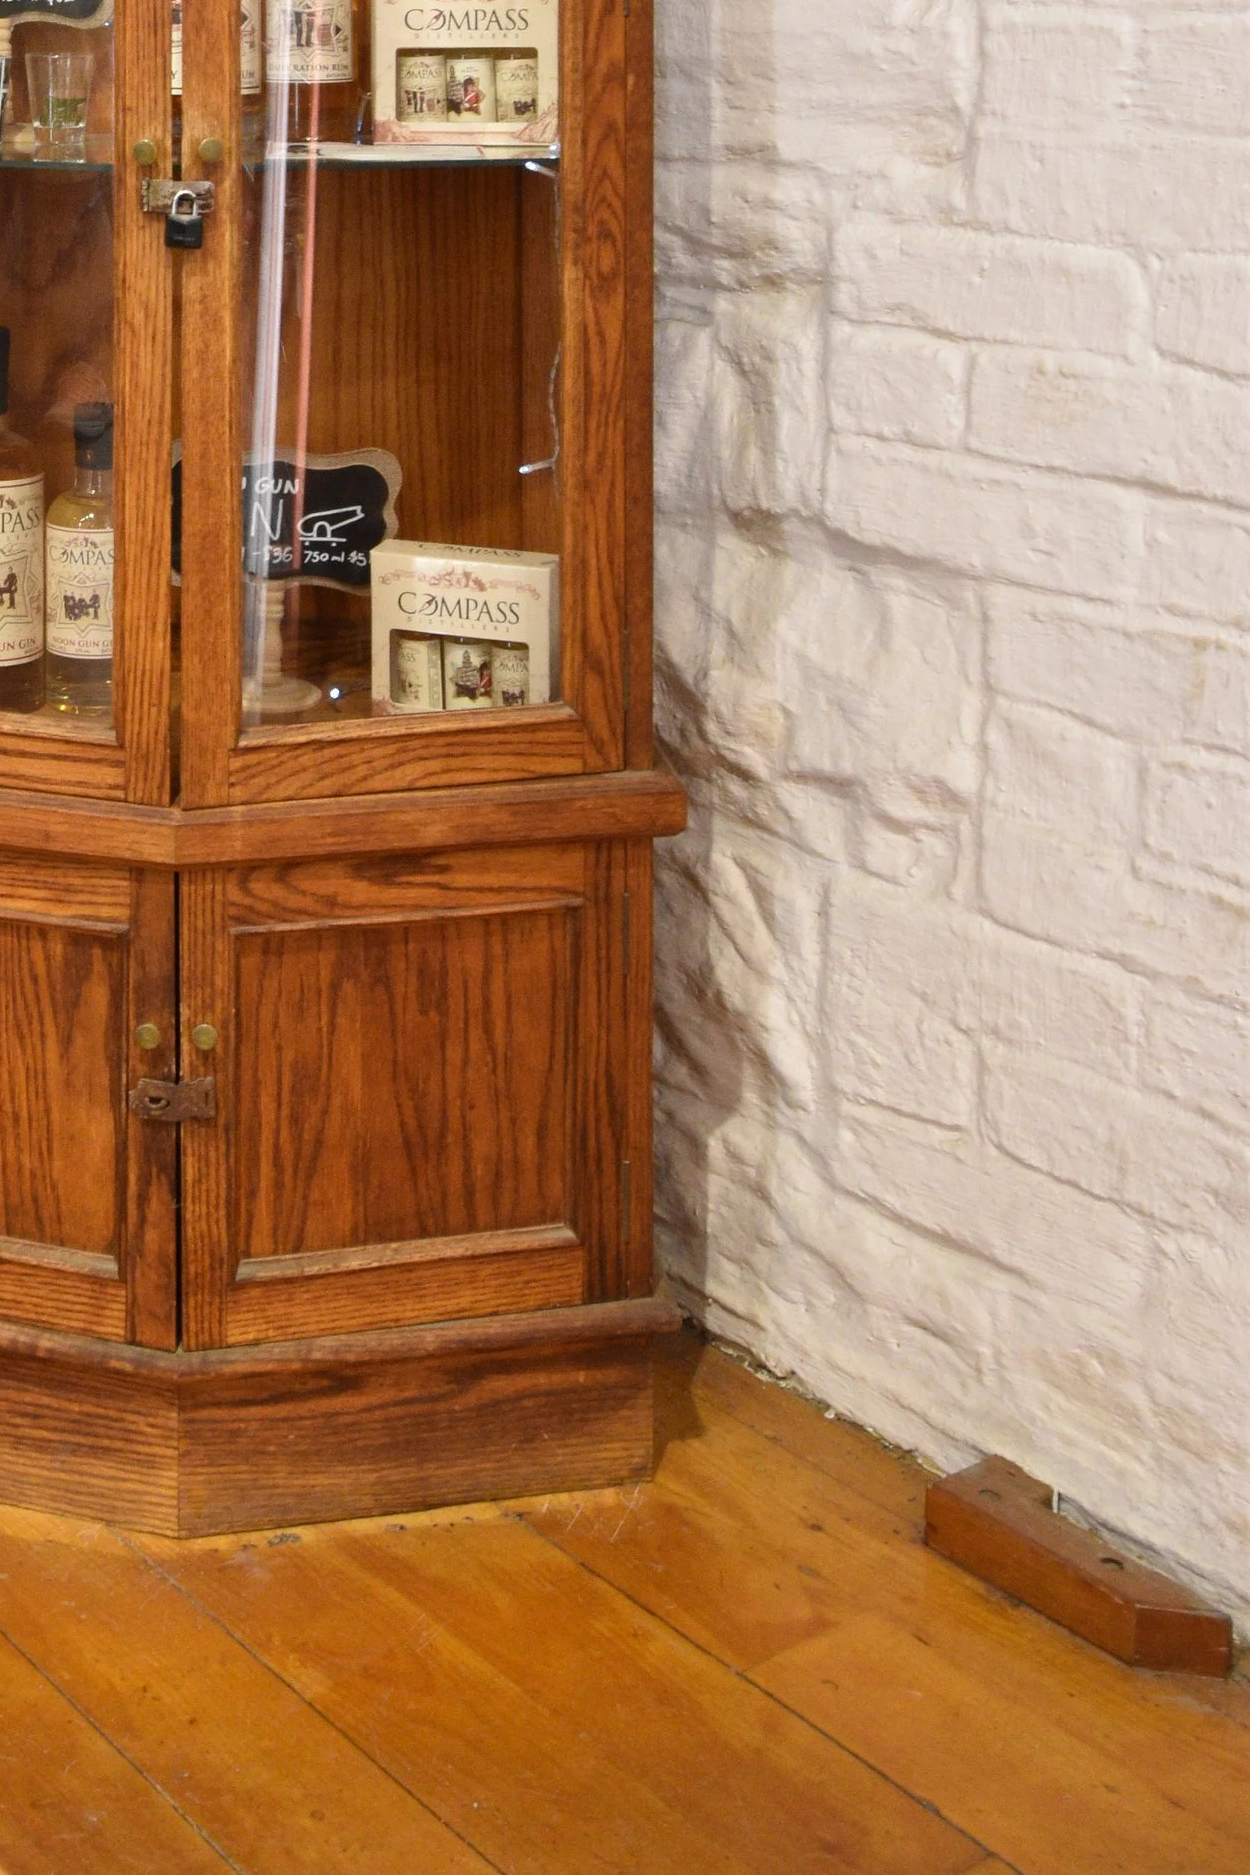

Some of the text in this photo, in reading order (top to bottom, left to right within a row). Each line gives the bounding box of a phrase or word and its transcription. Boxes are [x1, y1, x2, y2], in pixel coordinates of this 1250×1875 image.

[404, 8, 529, 31] COMPASS
[255, 477, 299, 494] GUN
[50, 545, 114, 565] COMPAS
[398, 591, 520, 625] COMPASS
[18, 637, 36, 650] GIN
